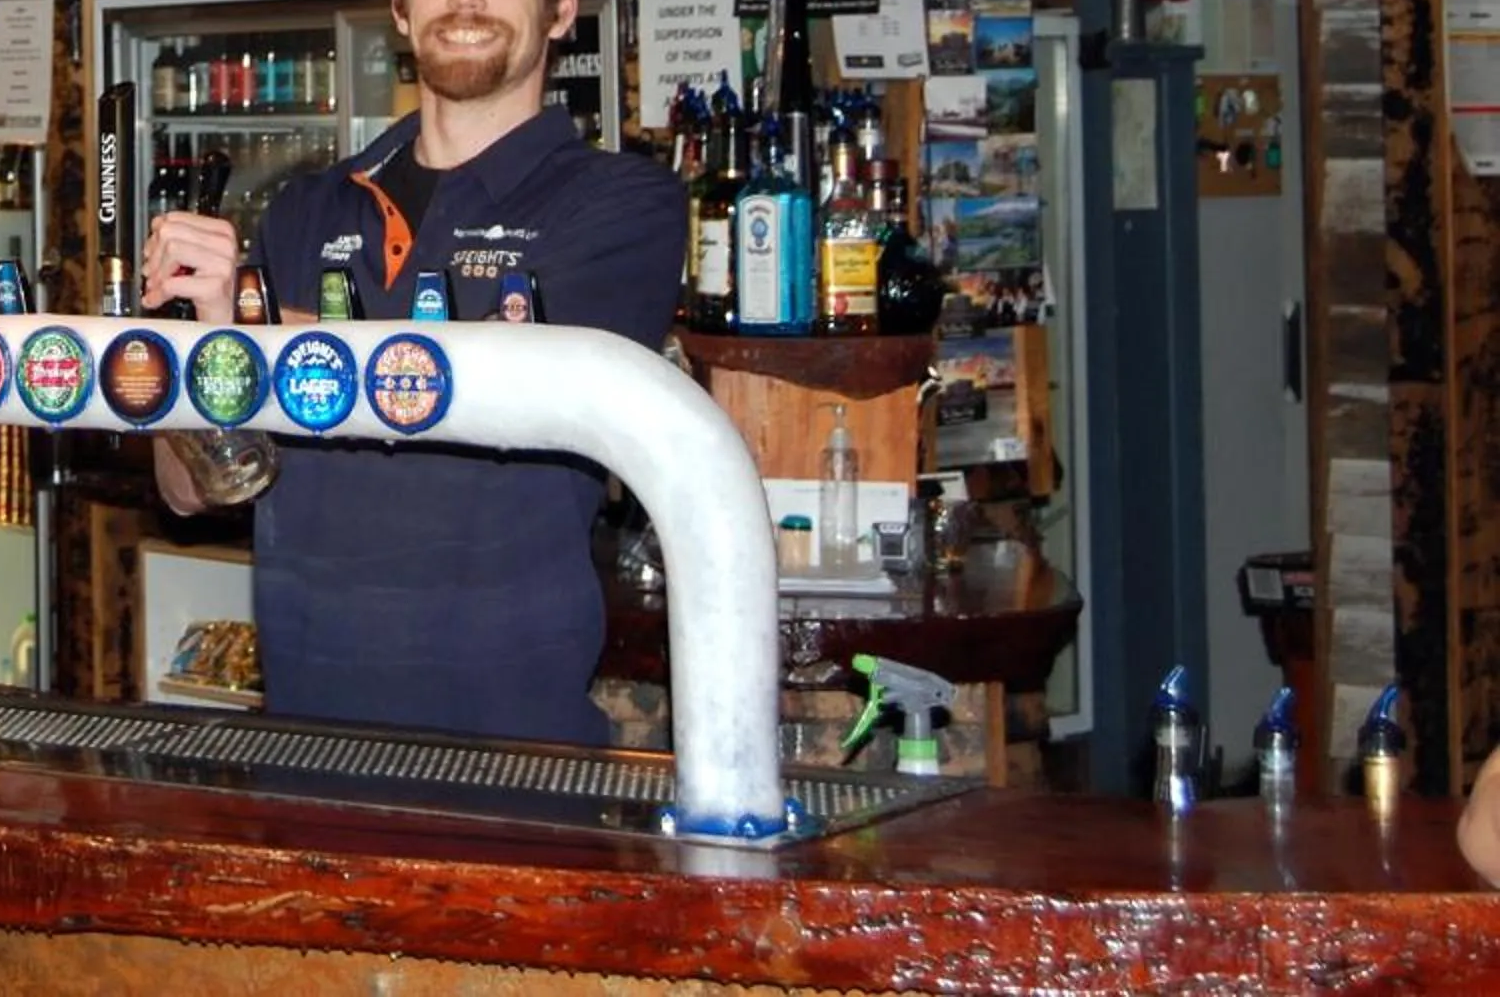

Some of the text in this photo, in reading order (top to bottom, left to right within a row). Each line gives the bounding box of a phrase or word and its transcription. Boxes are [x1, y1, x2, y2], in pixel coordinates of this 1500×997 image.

[658, 5, 716, 19] UNDER THE
[655, 27, 723, 42] SUPERVISION
[665, 49, 712, 63] OF THEIR
[658, 73, 705, 86] PARENTS
[99, 132, 117, 225] GUINNESS
[289, 378, 340, 395] LAGER
